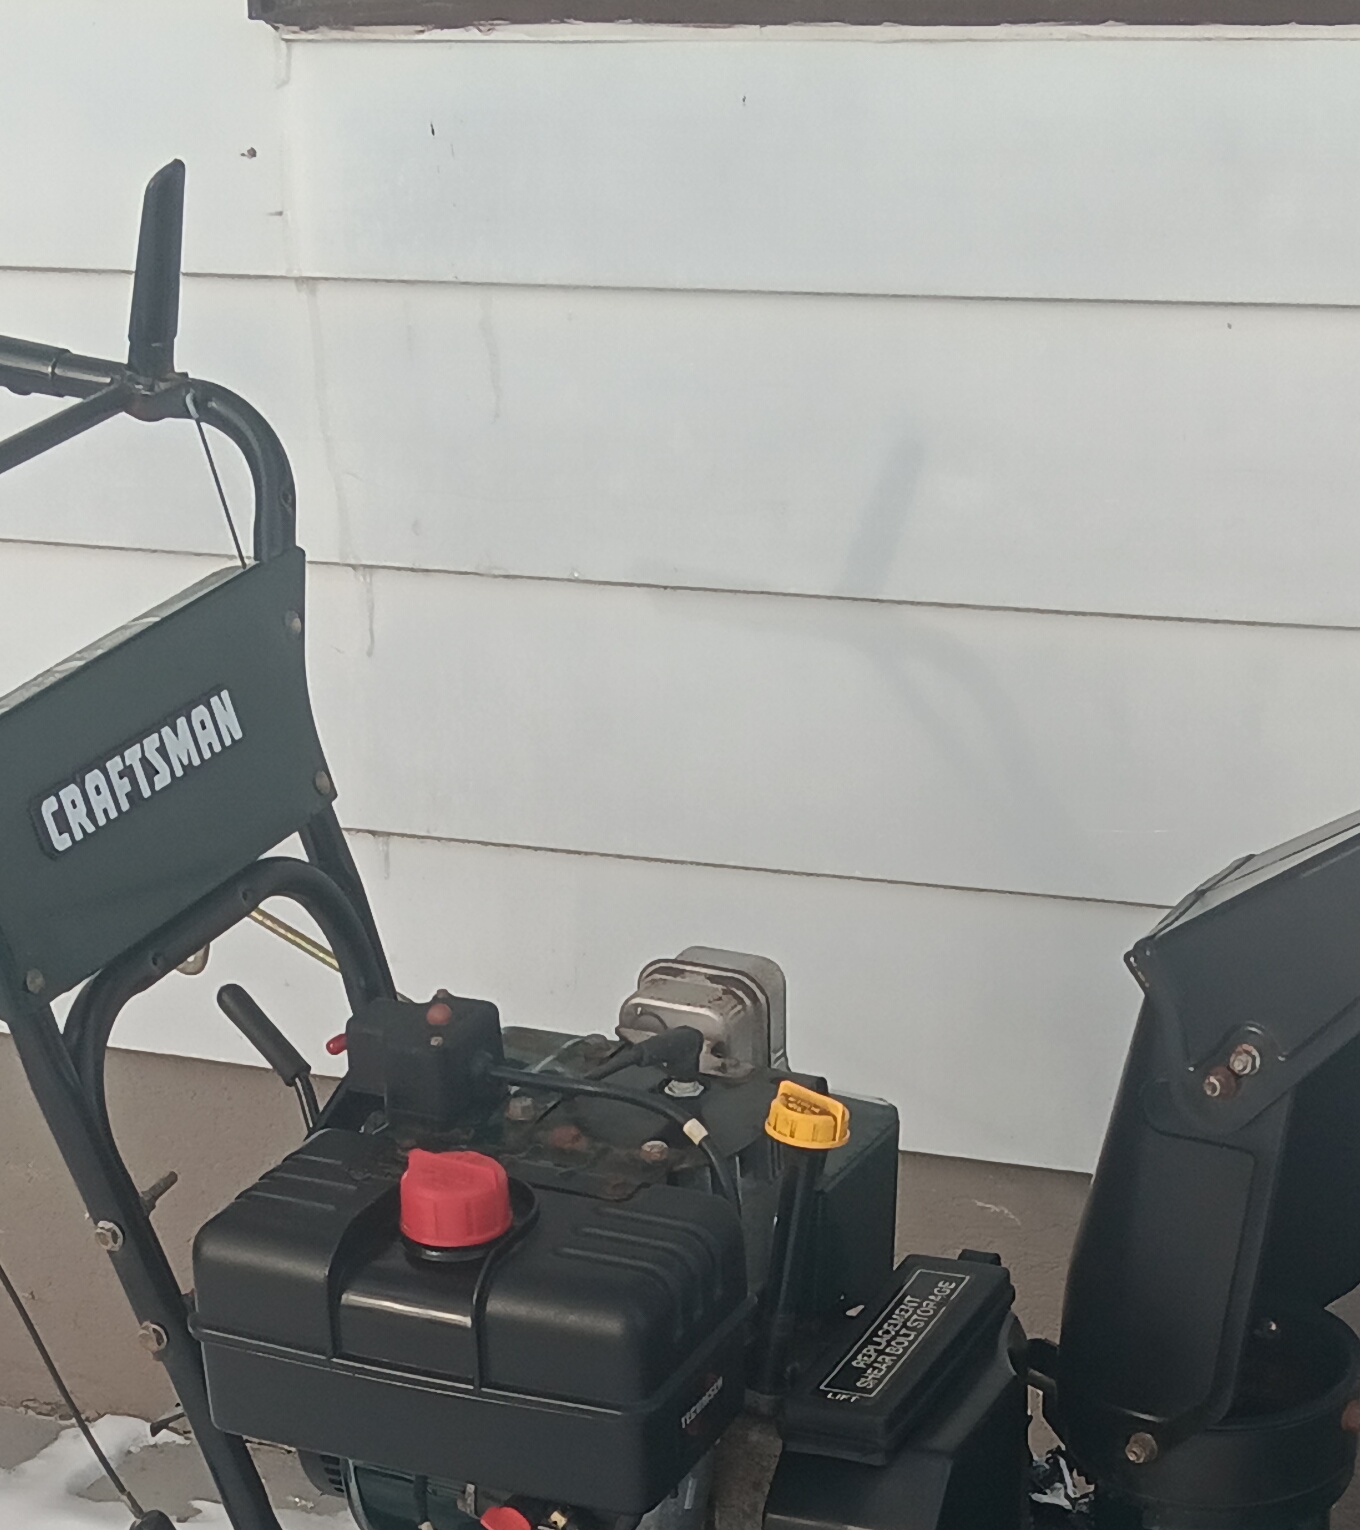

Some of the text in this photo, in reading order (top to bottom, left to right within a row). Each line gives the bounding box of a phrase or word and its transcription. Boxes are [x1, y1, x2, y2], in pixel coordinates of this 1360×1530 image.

[41, 689, 243, 851] CRAFTSMAN
[851, 1295, 921, 1368] REPLACEMENT
[856, 1281, 956, 1389] SHEAR BOLT STORAGE
[827, 1393, 859, 1402] LIFT
